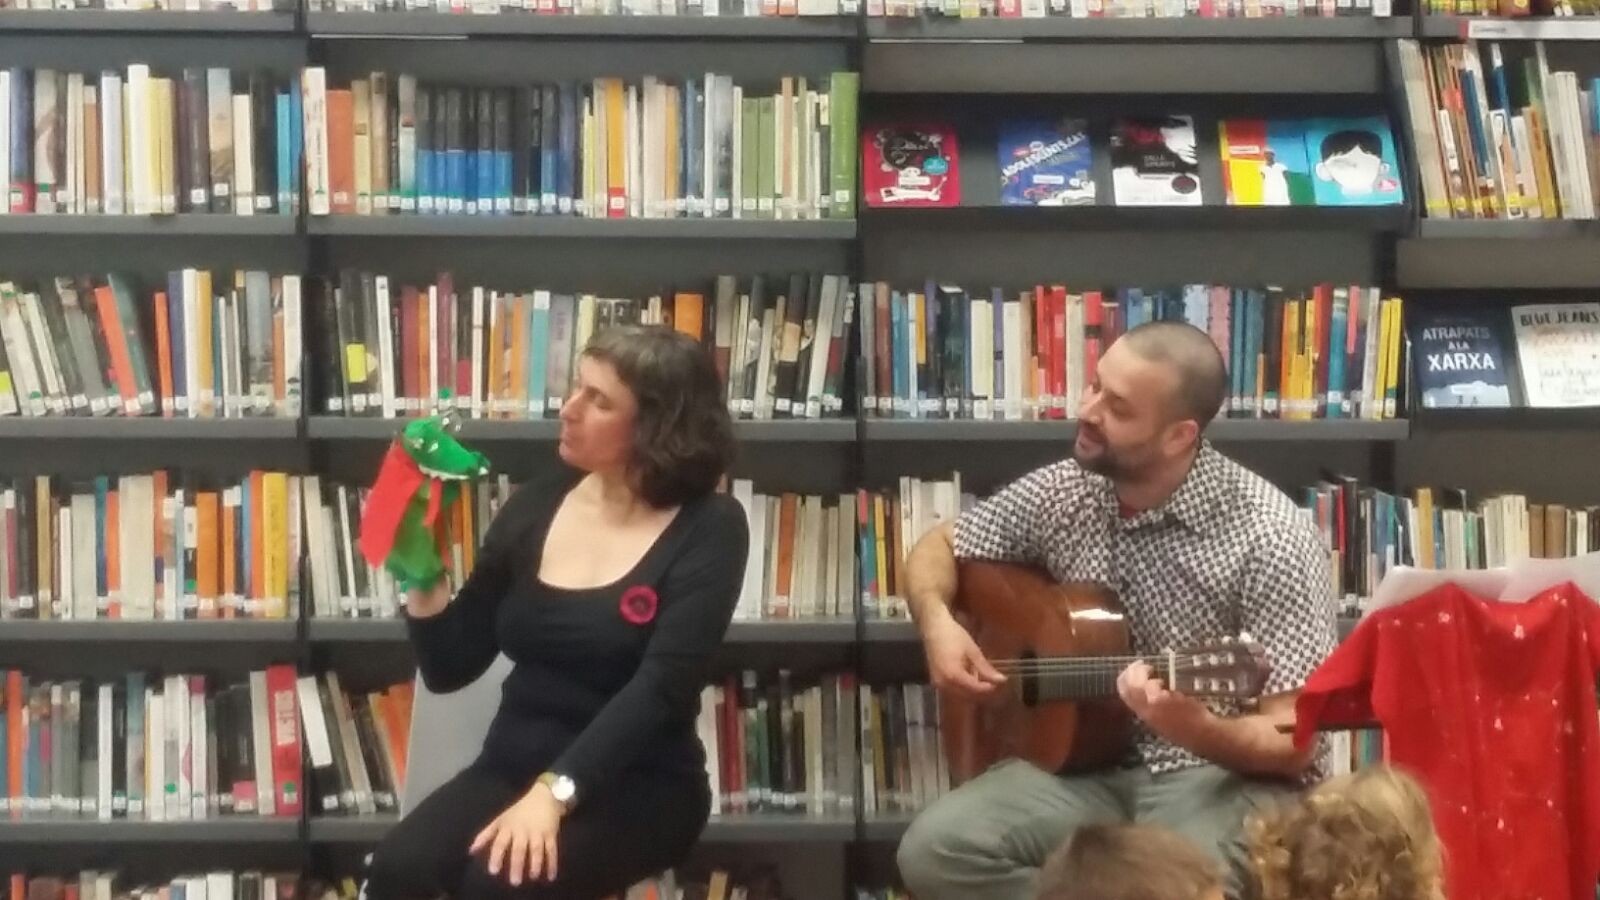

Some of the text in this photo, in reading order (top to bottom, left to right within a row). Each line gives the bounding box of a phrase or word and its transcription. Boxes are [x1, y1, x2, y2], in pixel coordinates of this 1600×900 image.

[1520, 311, 1600, 326] BLUE JEANS
[1422, 326, 1491, 340] ATRAPATS
[1427, 352, 1497, 372] XARXA
